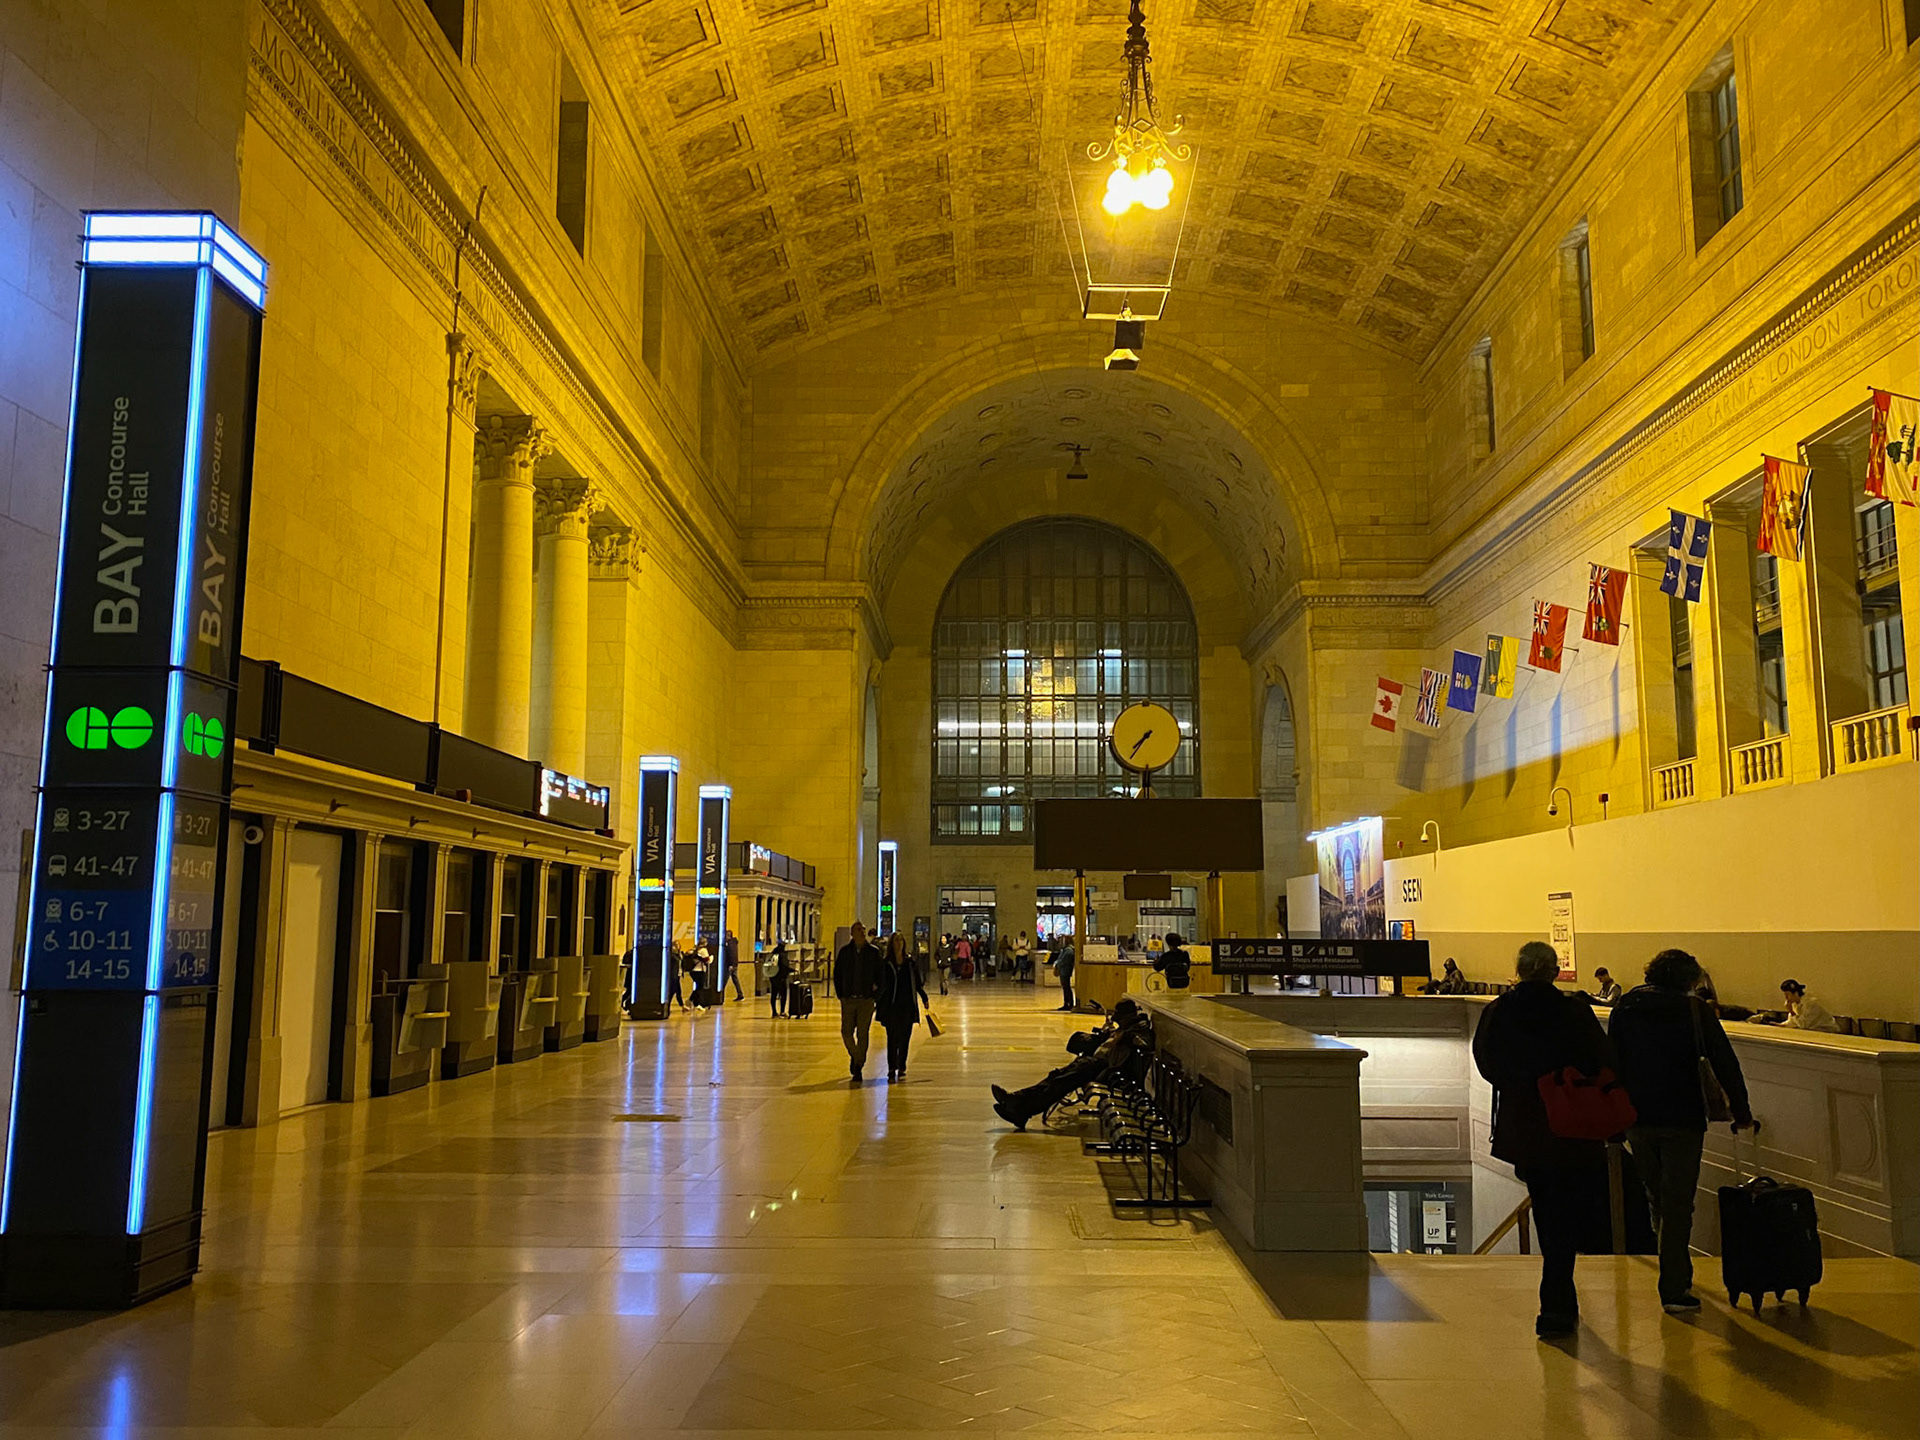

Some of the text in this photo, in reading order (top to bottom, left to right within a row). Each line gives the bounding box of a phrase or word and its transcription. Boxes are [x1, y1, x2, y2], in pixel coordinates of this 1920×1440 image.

[259, 20, 371, 184] MONTREAL
[384, 175, 457, 289] HAMILTON
[1705, 379, 1757, 429] SARNIA
[1766, 314, 1842, 385] LONDON
[102, 395, 130, 515] Concourse
[206, 411, 225, 527] Concourse
[127, 470, 150, 517] Hall
[216, 491, 231, 537] Hall
[93, 521, 146, 635] BAY
[198, 533, 228, 648] BAY
[741, 612, 848, 627] VANCOUVER
[65, 706, 154, 750] GO
[76, 810, 131, 831] 3-27
[184, 814, 212, 836] 3-27
[646, 838, 660, 863] VIA
[72, 856, 139, 877] 41-47
[181, 856, 214, 880] 41-47
[704, 853, 717, 875] VIA
[69, 900, 109, 922] 6-7
[178, 901, 198, 923] 6-7
[67, 929, 133, 951] 10-11
[176, 930, 208, 951] 10-11
[65, 959, 131, 981] 14-15
[174, 956, 208, 979] 14-15
[1427, 1227, 1440, 1236] UP
